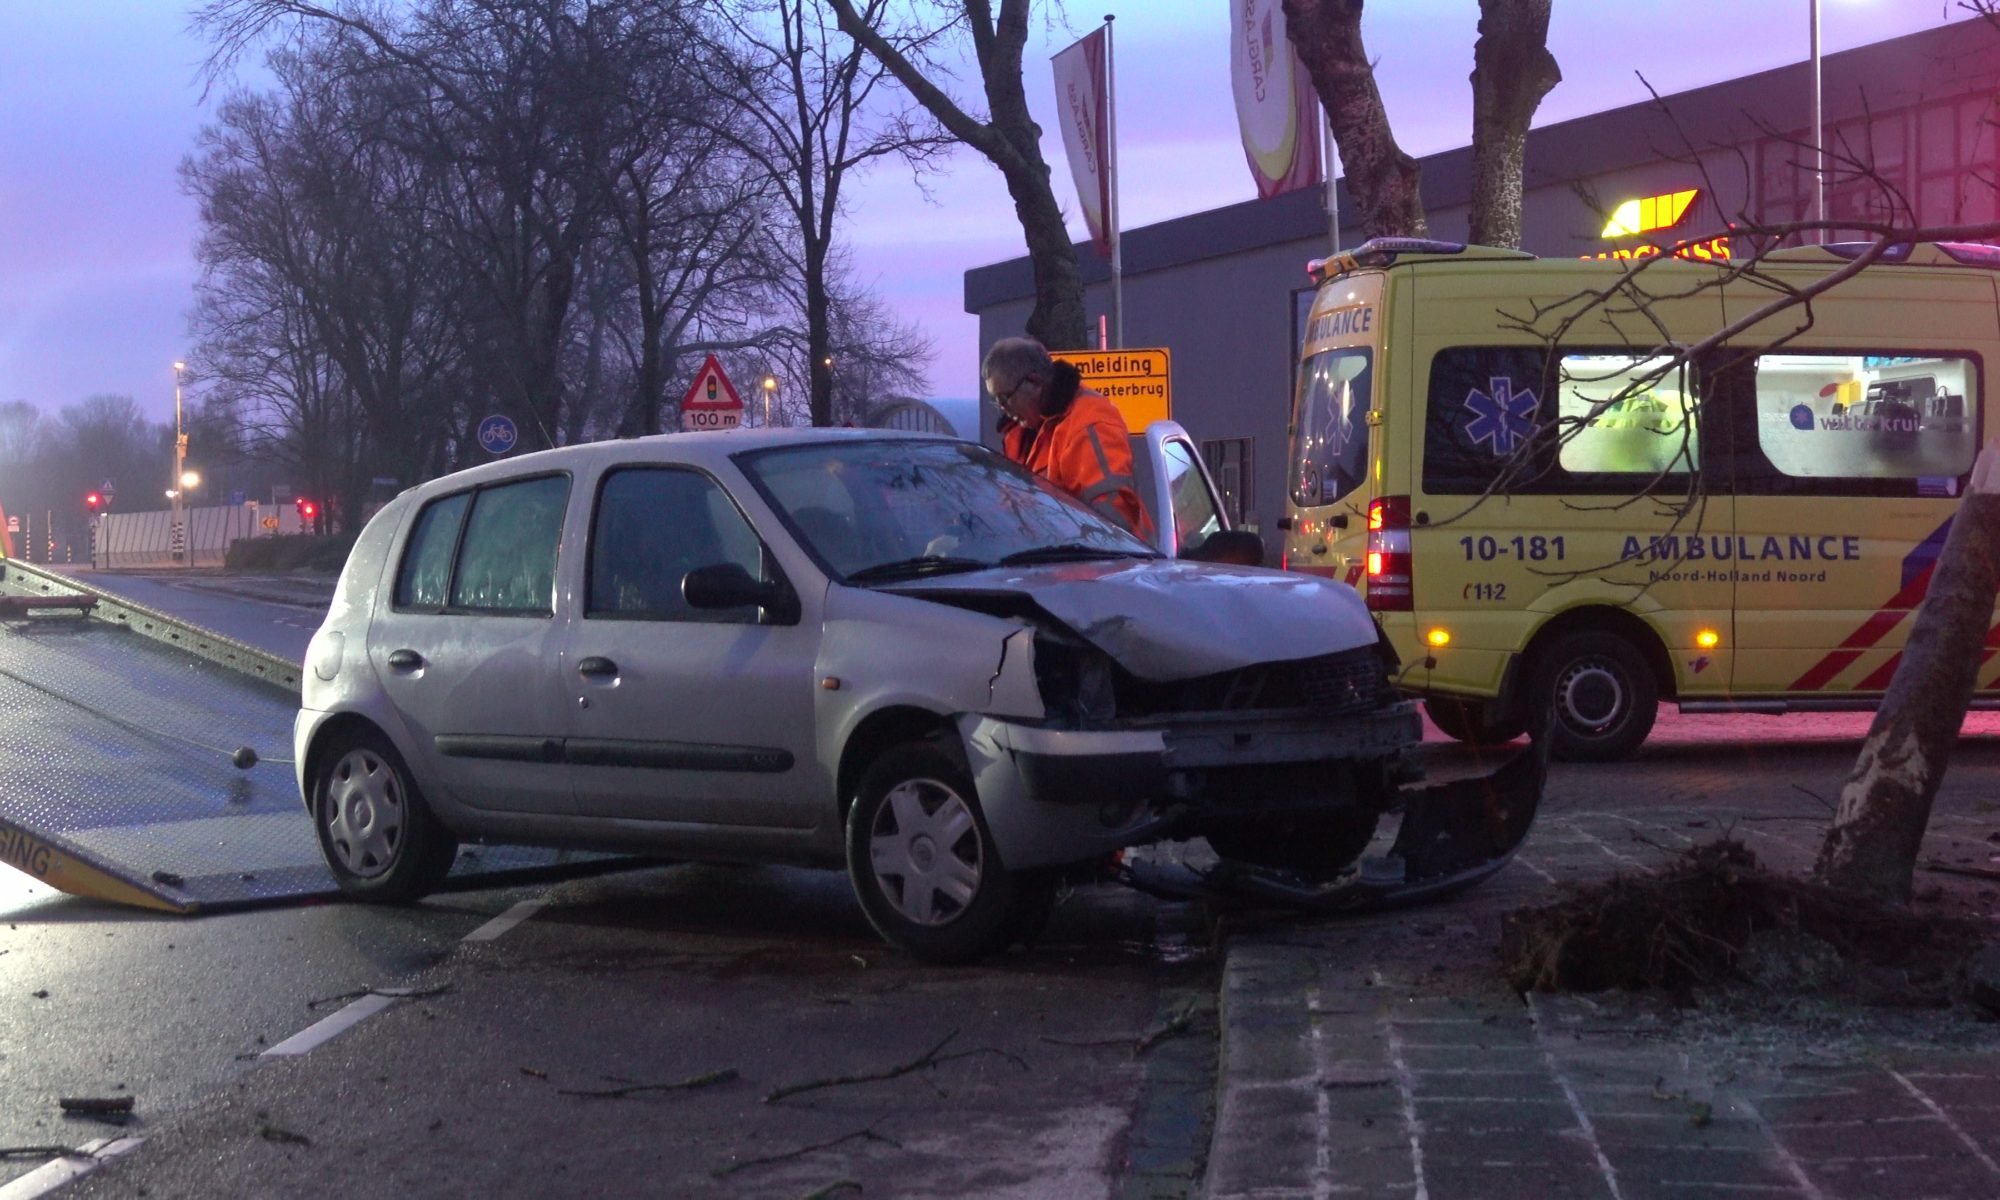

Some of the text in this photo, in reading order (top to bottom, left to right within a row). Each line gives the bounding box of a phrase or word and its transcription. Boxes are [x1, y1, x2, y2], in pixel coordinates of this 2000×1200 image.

[1075, 357, 1152, 376] mleiding
[691, 413, 736, 426] 100 m
[1460, 536, 1565, 561] 10-181
[1620, 536, 1860, 561] AMBULANCE
[1650, 570, 1827, 583] Noord-Holland Noord
